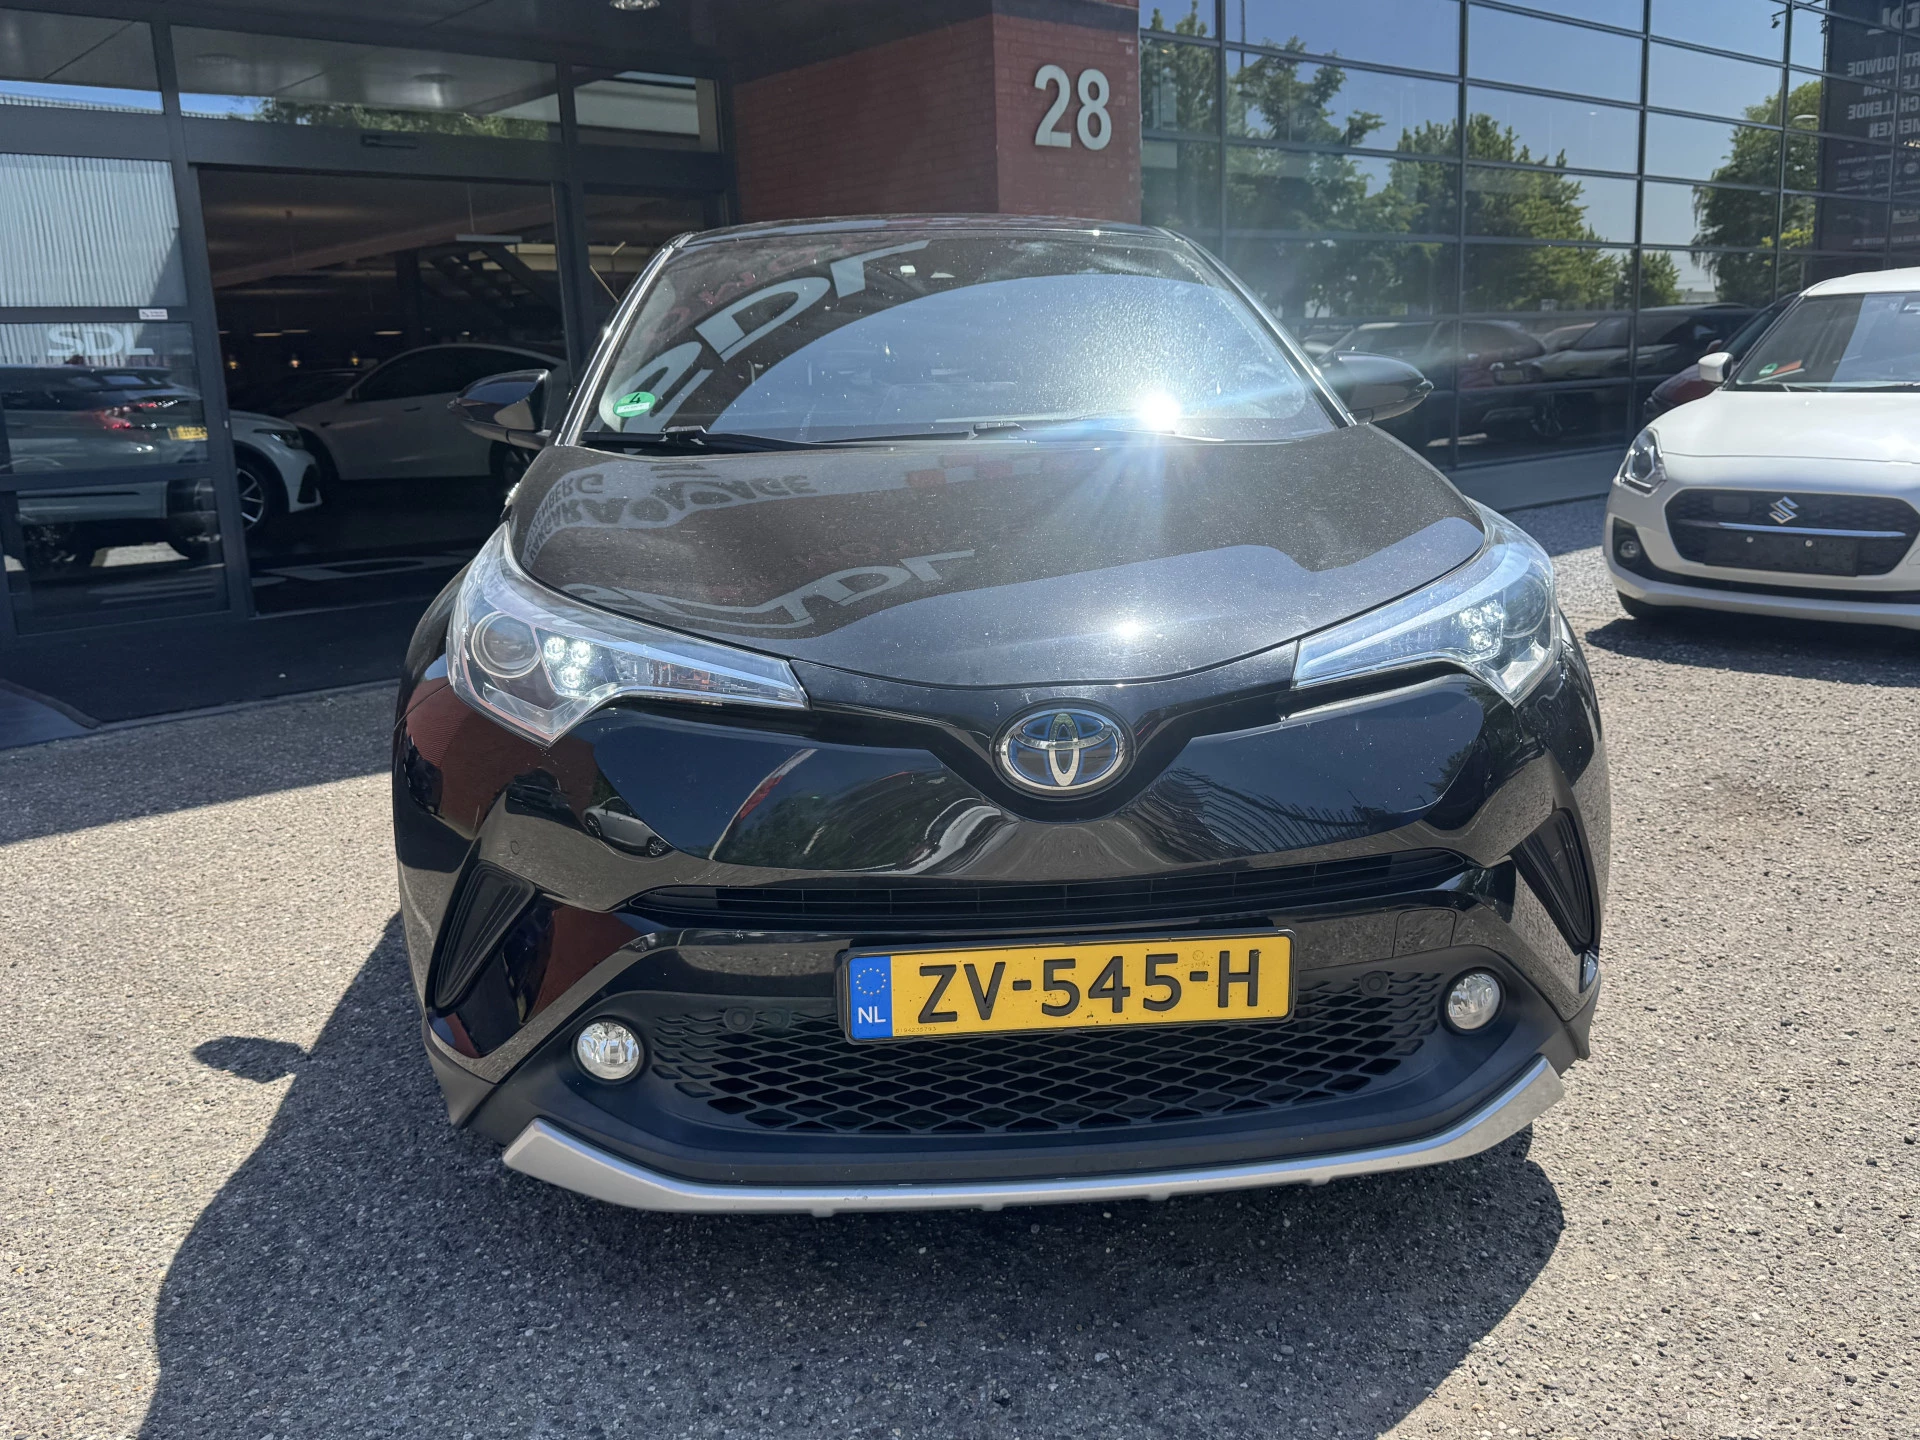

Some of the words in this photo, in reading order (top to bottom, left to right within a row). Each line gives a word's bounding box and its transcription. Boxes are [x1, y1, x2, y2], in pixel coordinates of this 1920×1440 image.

[1034, 64, 1112, 151] 28
[47, 323, 155, 357] SDL
[629, 392, 642, 404] 4
[917, 949, 1259, 1024] ZV-545-H
[857, 1006, 886, 1024] NL
